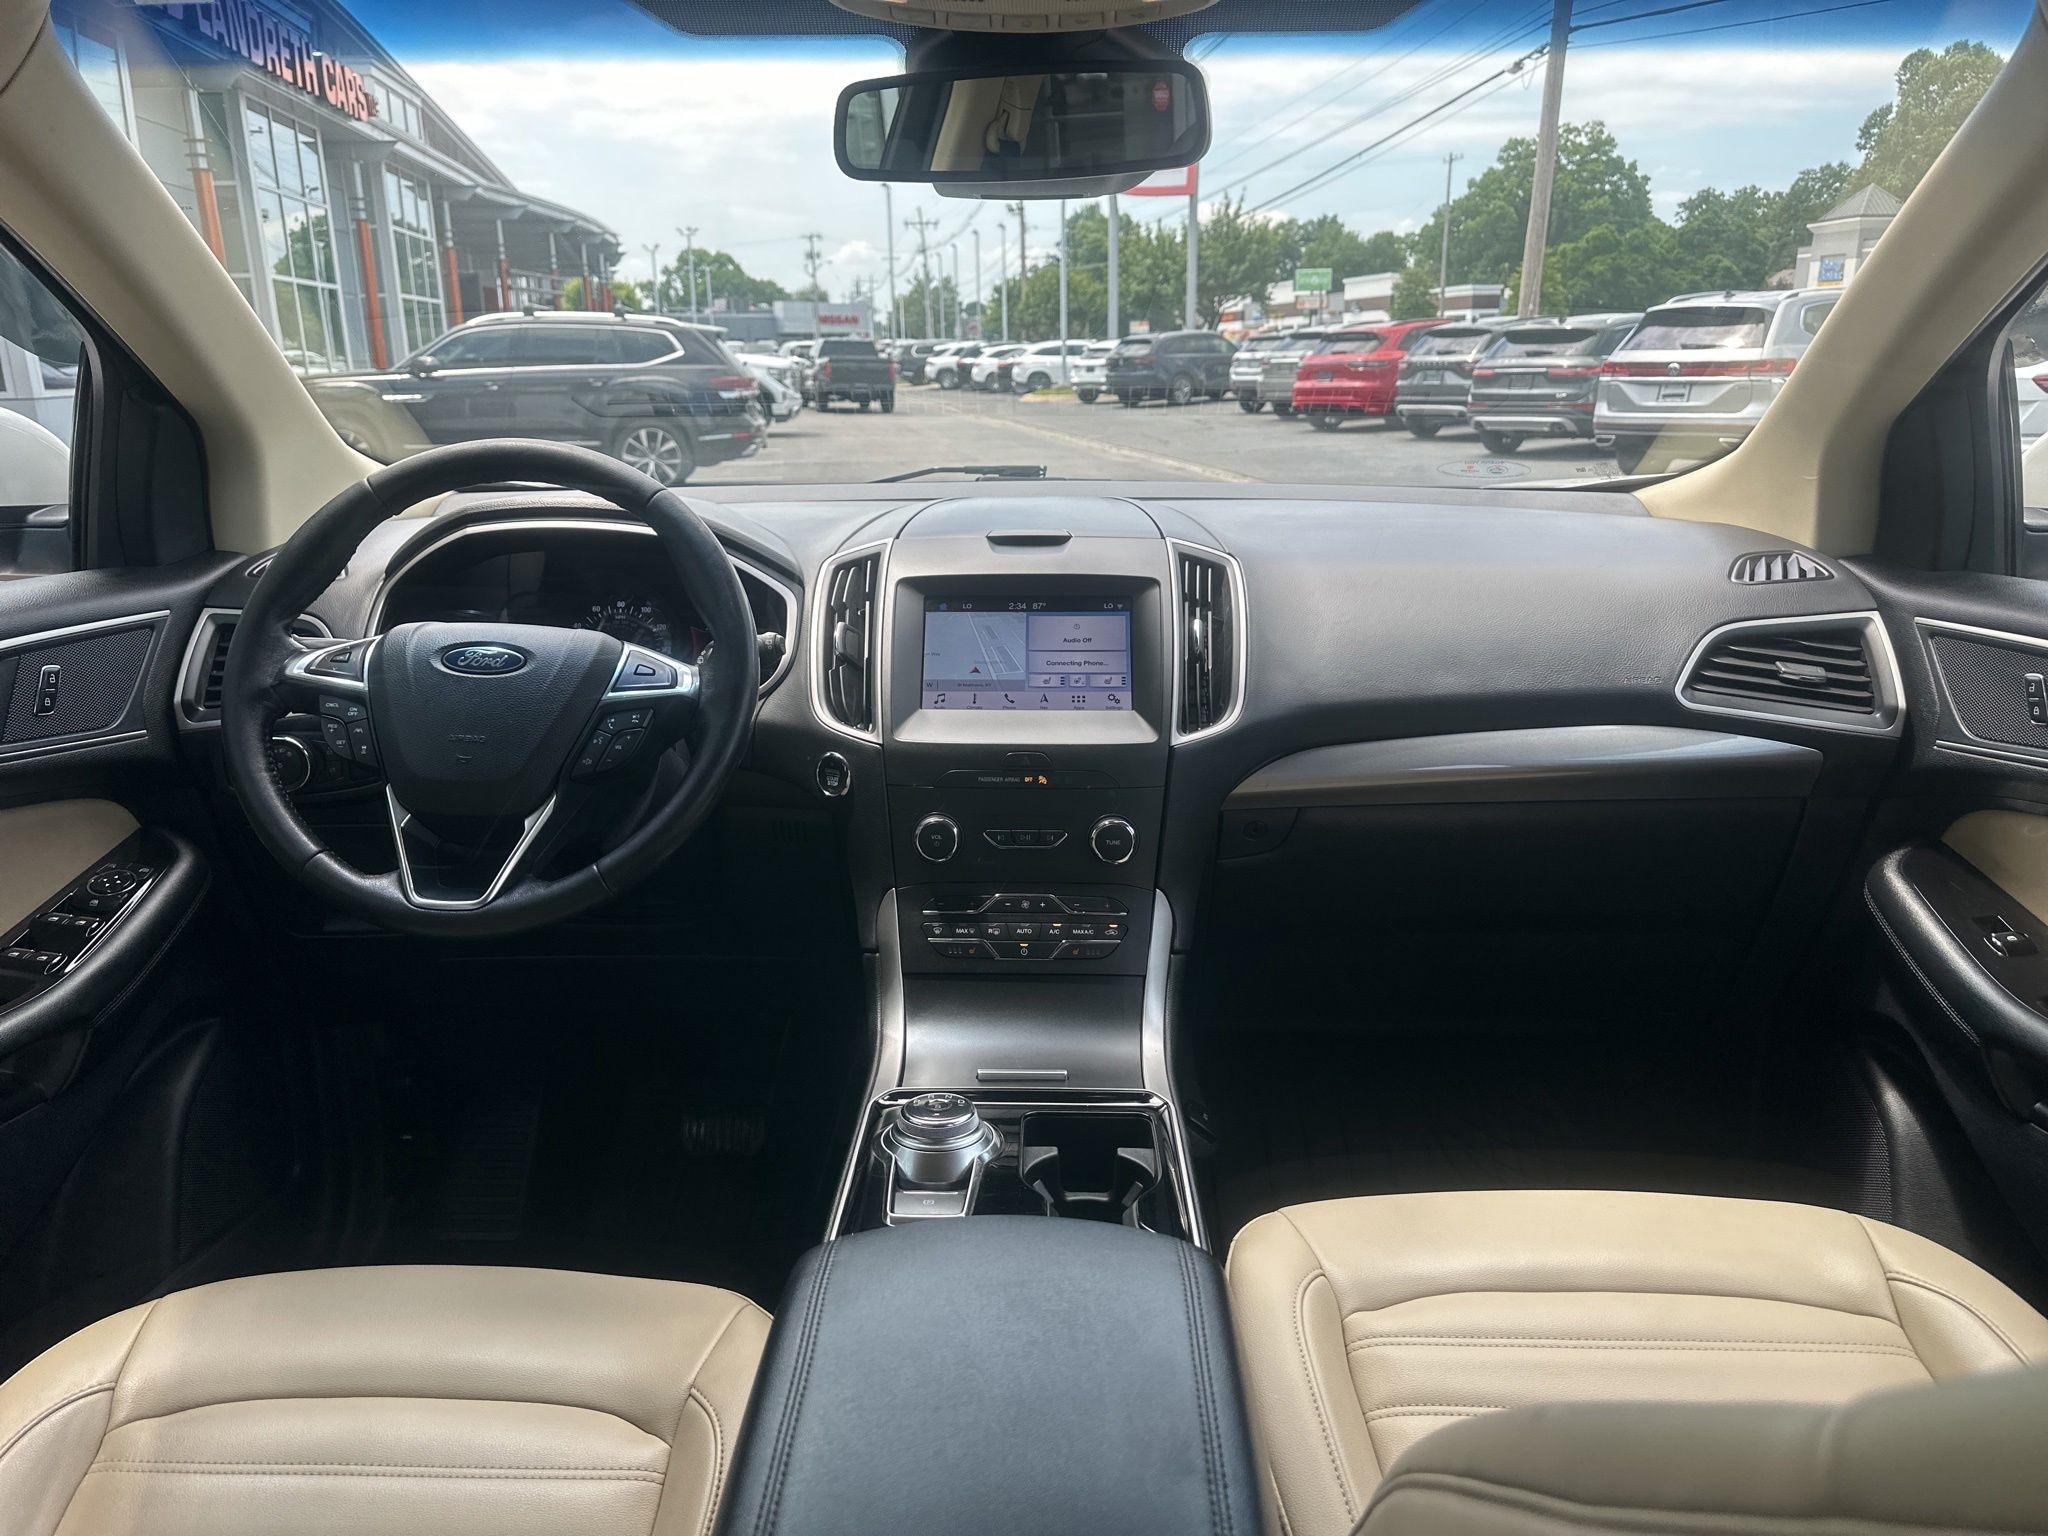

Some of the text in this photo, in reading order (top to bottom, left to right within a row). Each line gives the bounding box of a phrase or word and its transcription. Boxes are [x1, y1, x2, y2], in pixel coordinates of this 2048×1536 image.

[196, 0, 320, 97] LANDRETH
[321, 57, 369, 122] CARS
[1008, 602, 1027, 610] 2:34
[457, 650, 509, 668] Ford
[1045, 659, 1082, 668] Connecting
